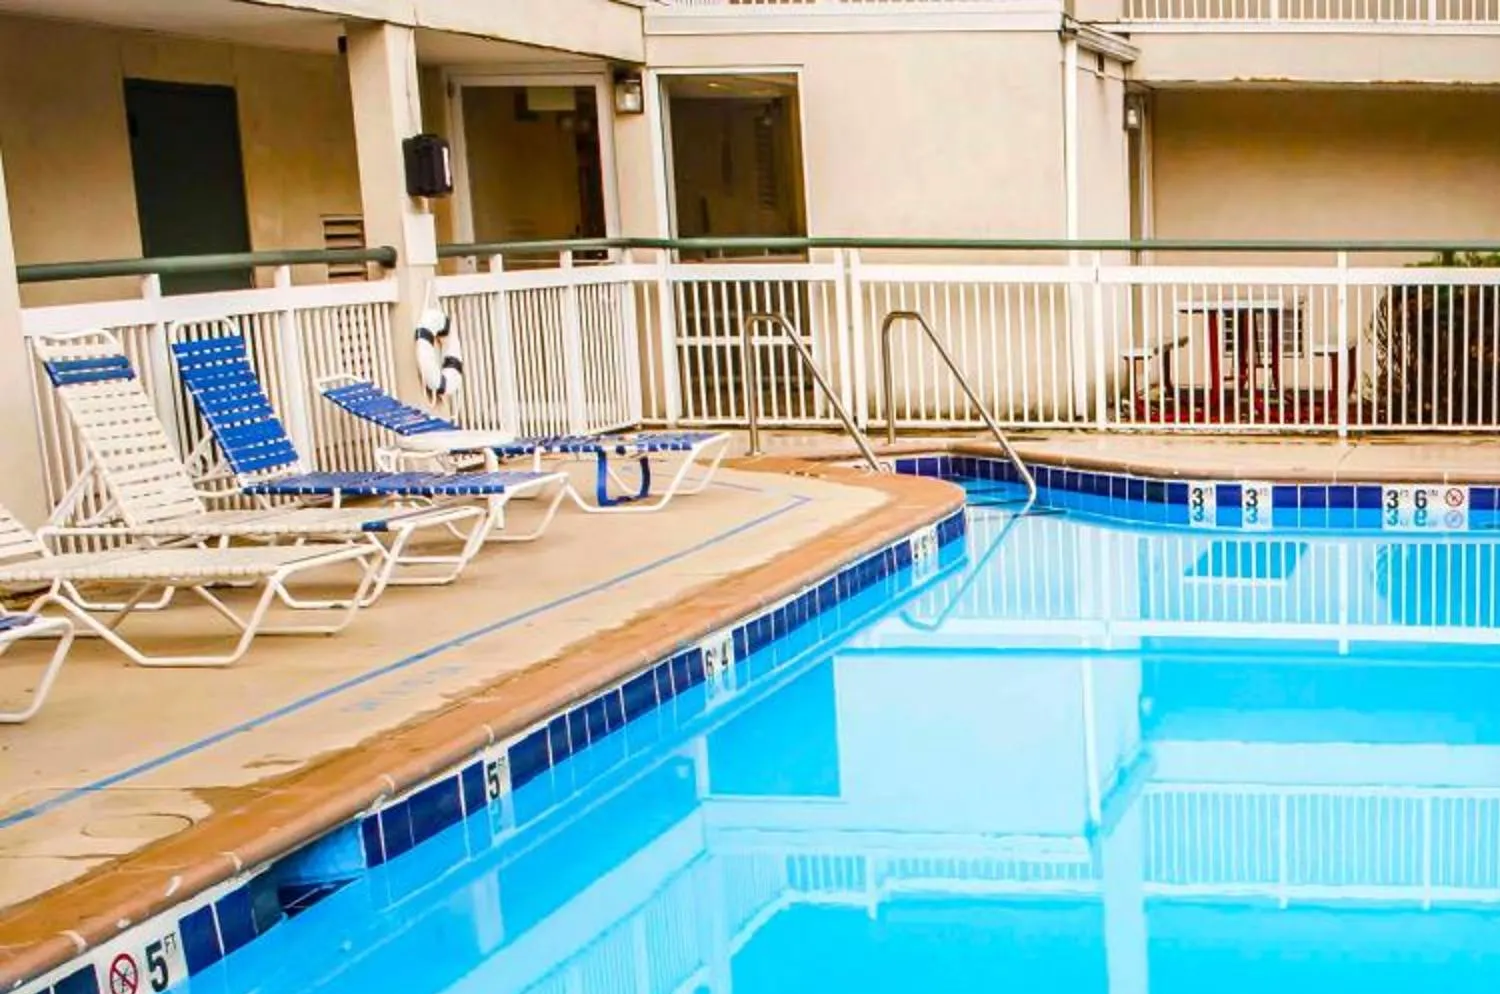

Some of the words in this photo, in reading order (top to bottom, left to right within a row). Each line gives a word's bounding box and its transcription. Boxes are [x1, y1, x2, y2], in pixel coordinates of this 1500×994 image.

[1192, 487, 1204, 507] 3
[1245, 487, 1258, 507] 3
[1386, 489, 1399, 509] 3
[1414, 489, 1427, 509] 6
[487, 761, 500, 800] 5
[145, 939, 169, 992] 5
[164, 931, 178, 954] FT
